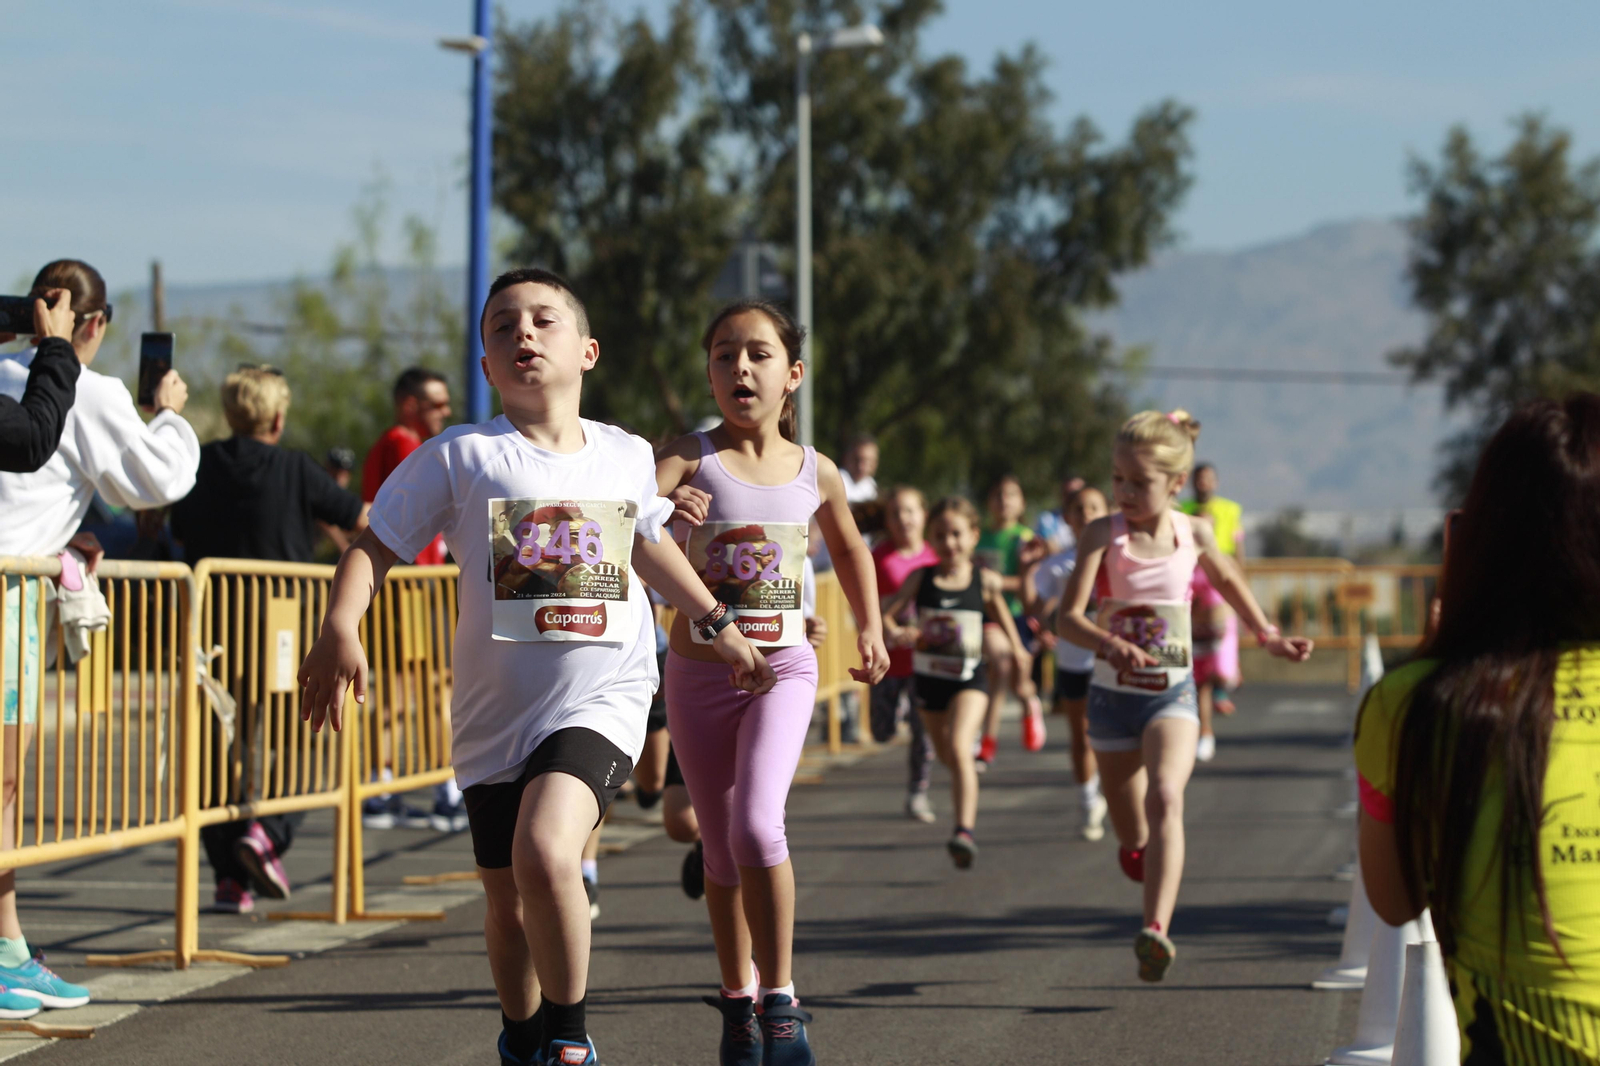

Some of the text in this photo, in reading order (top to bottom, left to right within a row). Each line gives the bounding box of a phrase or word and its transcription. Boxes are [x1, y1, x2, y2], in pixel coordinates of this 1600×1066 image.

[513, 520, 604, 566] 846
[704, 541, 783, 580] 862
[580, 563, 620, 576] XIII
[760, 578, 796, 589] XIII
[736, 619, 780, 634] aparrós
